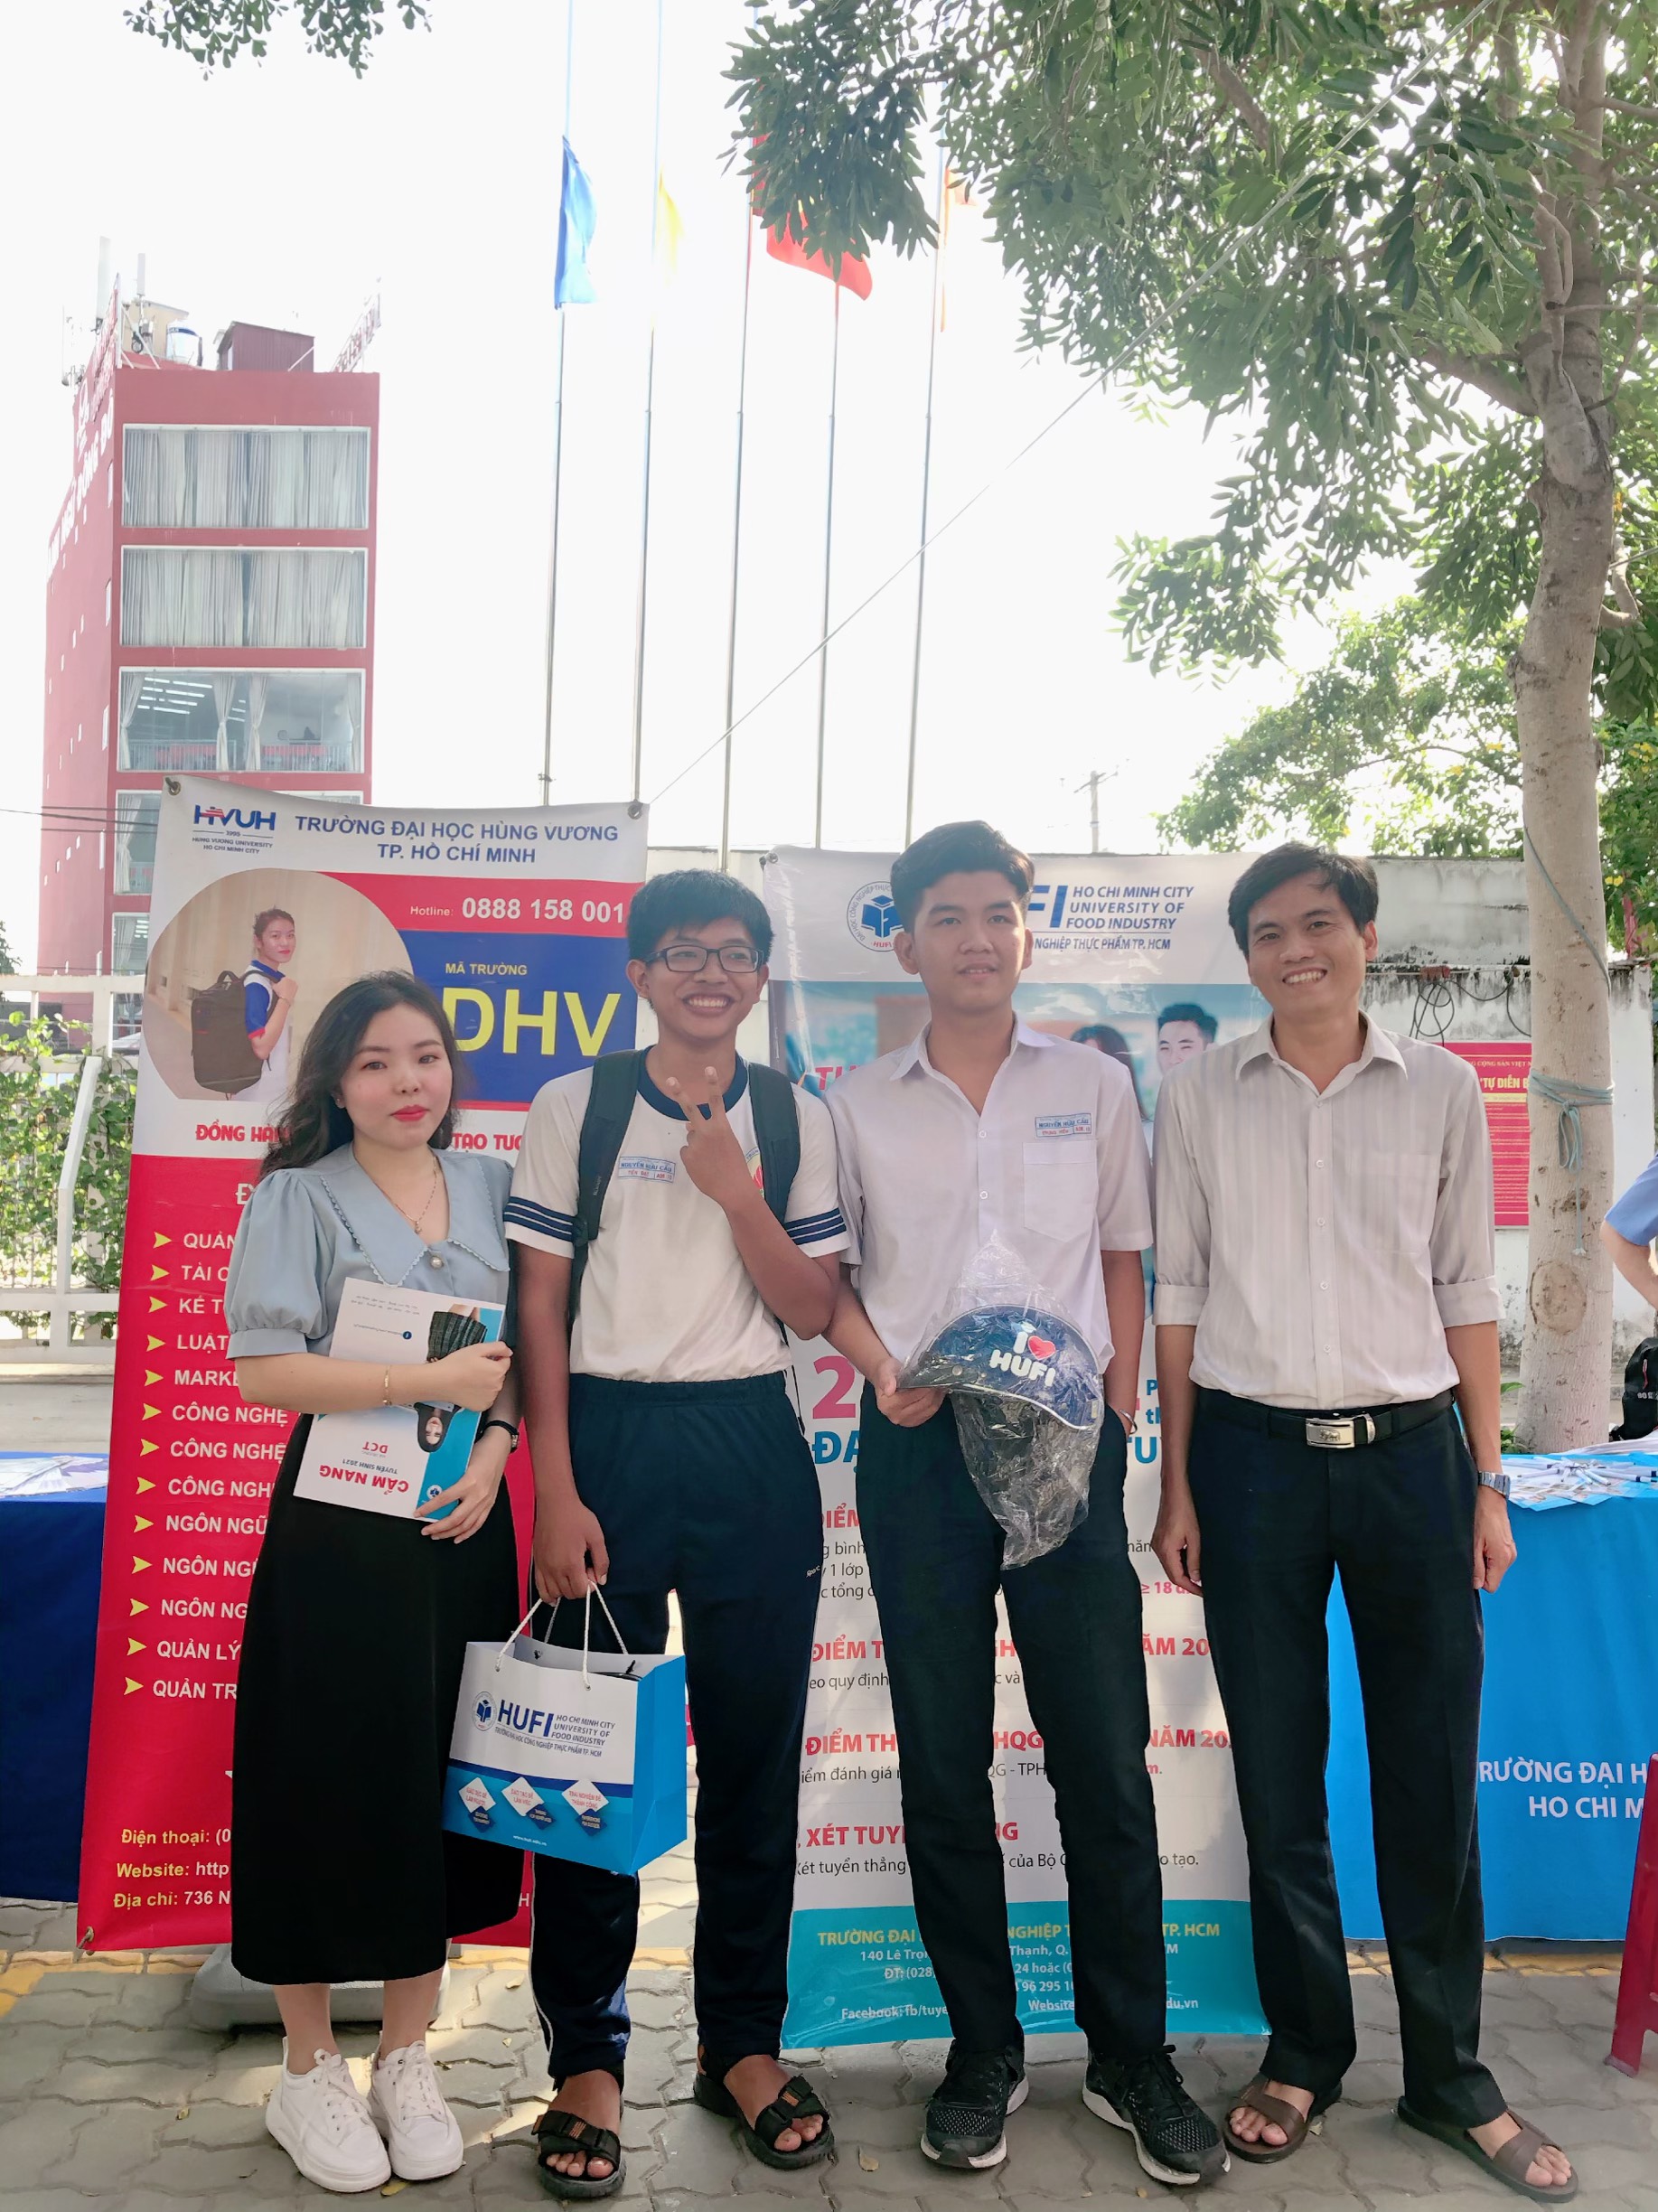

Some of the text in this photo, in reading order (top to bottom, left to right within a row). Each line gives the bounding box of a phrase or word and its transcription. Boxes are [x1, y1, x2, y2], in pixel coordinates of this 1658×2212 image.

[295, 815, 618, 842] TRƯỜNG ĐẠI HỌC HÙNG VƯƠNG
[235, 840, 273, 848] UNIVERSITY
[377, 842, 536, 863] TP. HỒ CHÍ MINH
[1073, 886, 1194, 898] HO CHI MINH CITY
[410, 897, 623, 923] Hotline: 0888 158 001
[1070, 902, 1185, 914] UNIVERSITY OF
[1066, 918, 1176, 929] FOOD INDUSTRY
[1035, 936, 1072, 951] NGHIỆP
[1148, 939, 1171, 950] HCM
[445, 961, 528, 976] MÃ TRƯỜNG
[443, 987, 621, 1056] DHV
[181, 1261, 211, 1281] TÀI
[177, 1333, 229, 1354] LUẬT
[1013, 1331, 1029, 1354] I
[989, 1349, 1056, 1387] HUFI
[172, 1401, 229, 1422] CÔNG
[170, 1438, 227, 1458] CÔNG
[362, 1441, 388, 1454] DCT
[319, 1465, 368, 1485] NANG
[360, 1461, 375, 1470] SINH
[168, 1476, 275, 1498] CÔNG NGH
[165, 1512, 221, 1533] NGÔN
[163, 1555, 217, 1577] NGÔN
[842, 1562, 863, 1579] lớp
[831, 1582, 864, 1600] tổng
[161, 1598, 248, 1619] NGÔN NG
[156, 1638, 210, 1660] QUẢN
[1142, 1634, 1176, 1655] ĂM
[1182, 1638, 1210, 1655] 20
[153, 1677, 238, 1701] QUẢN TR
[809, 1671, 1020, 1690] eo quy định và
[498, 1700, 554, 1738] HUFI
[581, 1718, 599, 1727] MINH
[599, 1721, 616, 1729] CITY
[551, 1731, 605, 1746] FOOD INDUSTRY
[554, 1723, 598, 1736] UNIVERSITY
[805, 1728, 862, 1756] ĐIỂM
[866, 1734, 896, 1752] TH
[994, 1730, 1044, 1751] HQG
[801, 1763, 1046, 1783] iểm đánh giá TPH
[1479, 1757, 1624, 1789] RƯỜNG ĐẠI
[1529, 1796, 1617, 1818] HO CHI
[121, 1829, 210, 1848] Điện thoại:
[806, 1823, 849, 1847] XÉT
[117, 1861, 229, 1879] Website: http
[819, 1853, 1199, 1876] tuyển thẳng của Bộ tạo.
[113, 1893, 142, 1910] Địa
[183, 1890, 213, 1905] 736
[818, 1928, 884, 1945] TRƯỜNG
[887, 1929, 915, 1945] ĐẠI
[1185, 1923, 1221, 1937] HCM
[860, 1950, 884, 1961] 140
[886, 1949, 901, 1960] Lê
[1009, 1945, 1053, 1958] Thạnh,
[1032, 1962, 1060, 1976] hoặc
[1039, 1981, 1061, 1992] 295
[905, 2004, 948, 2018] fb/tuye
